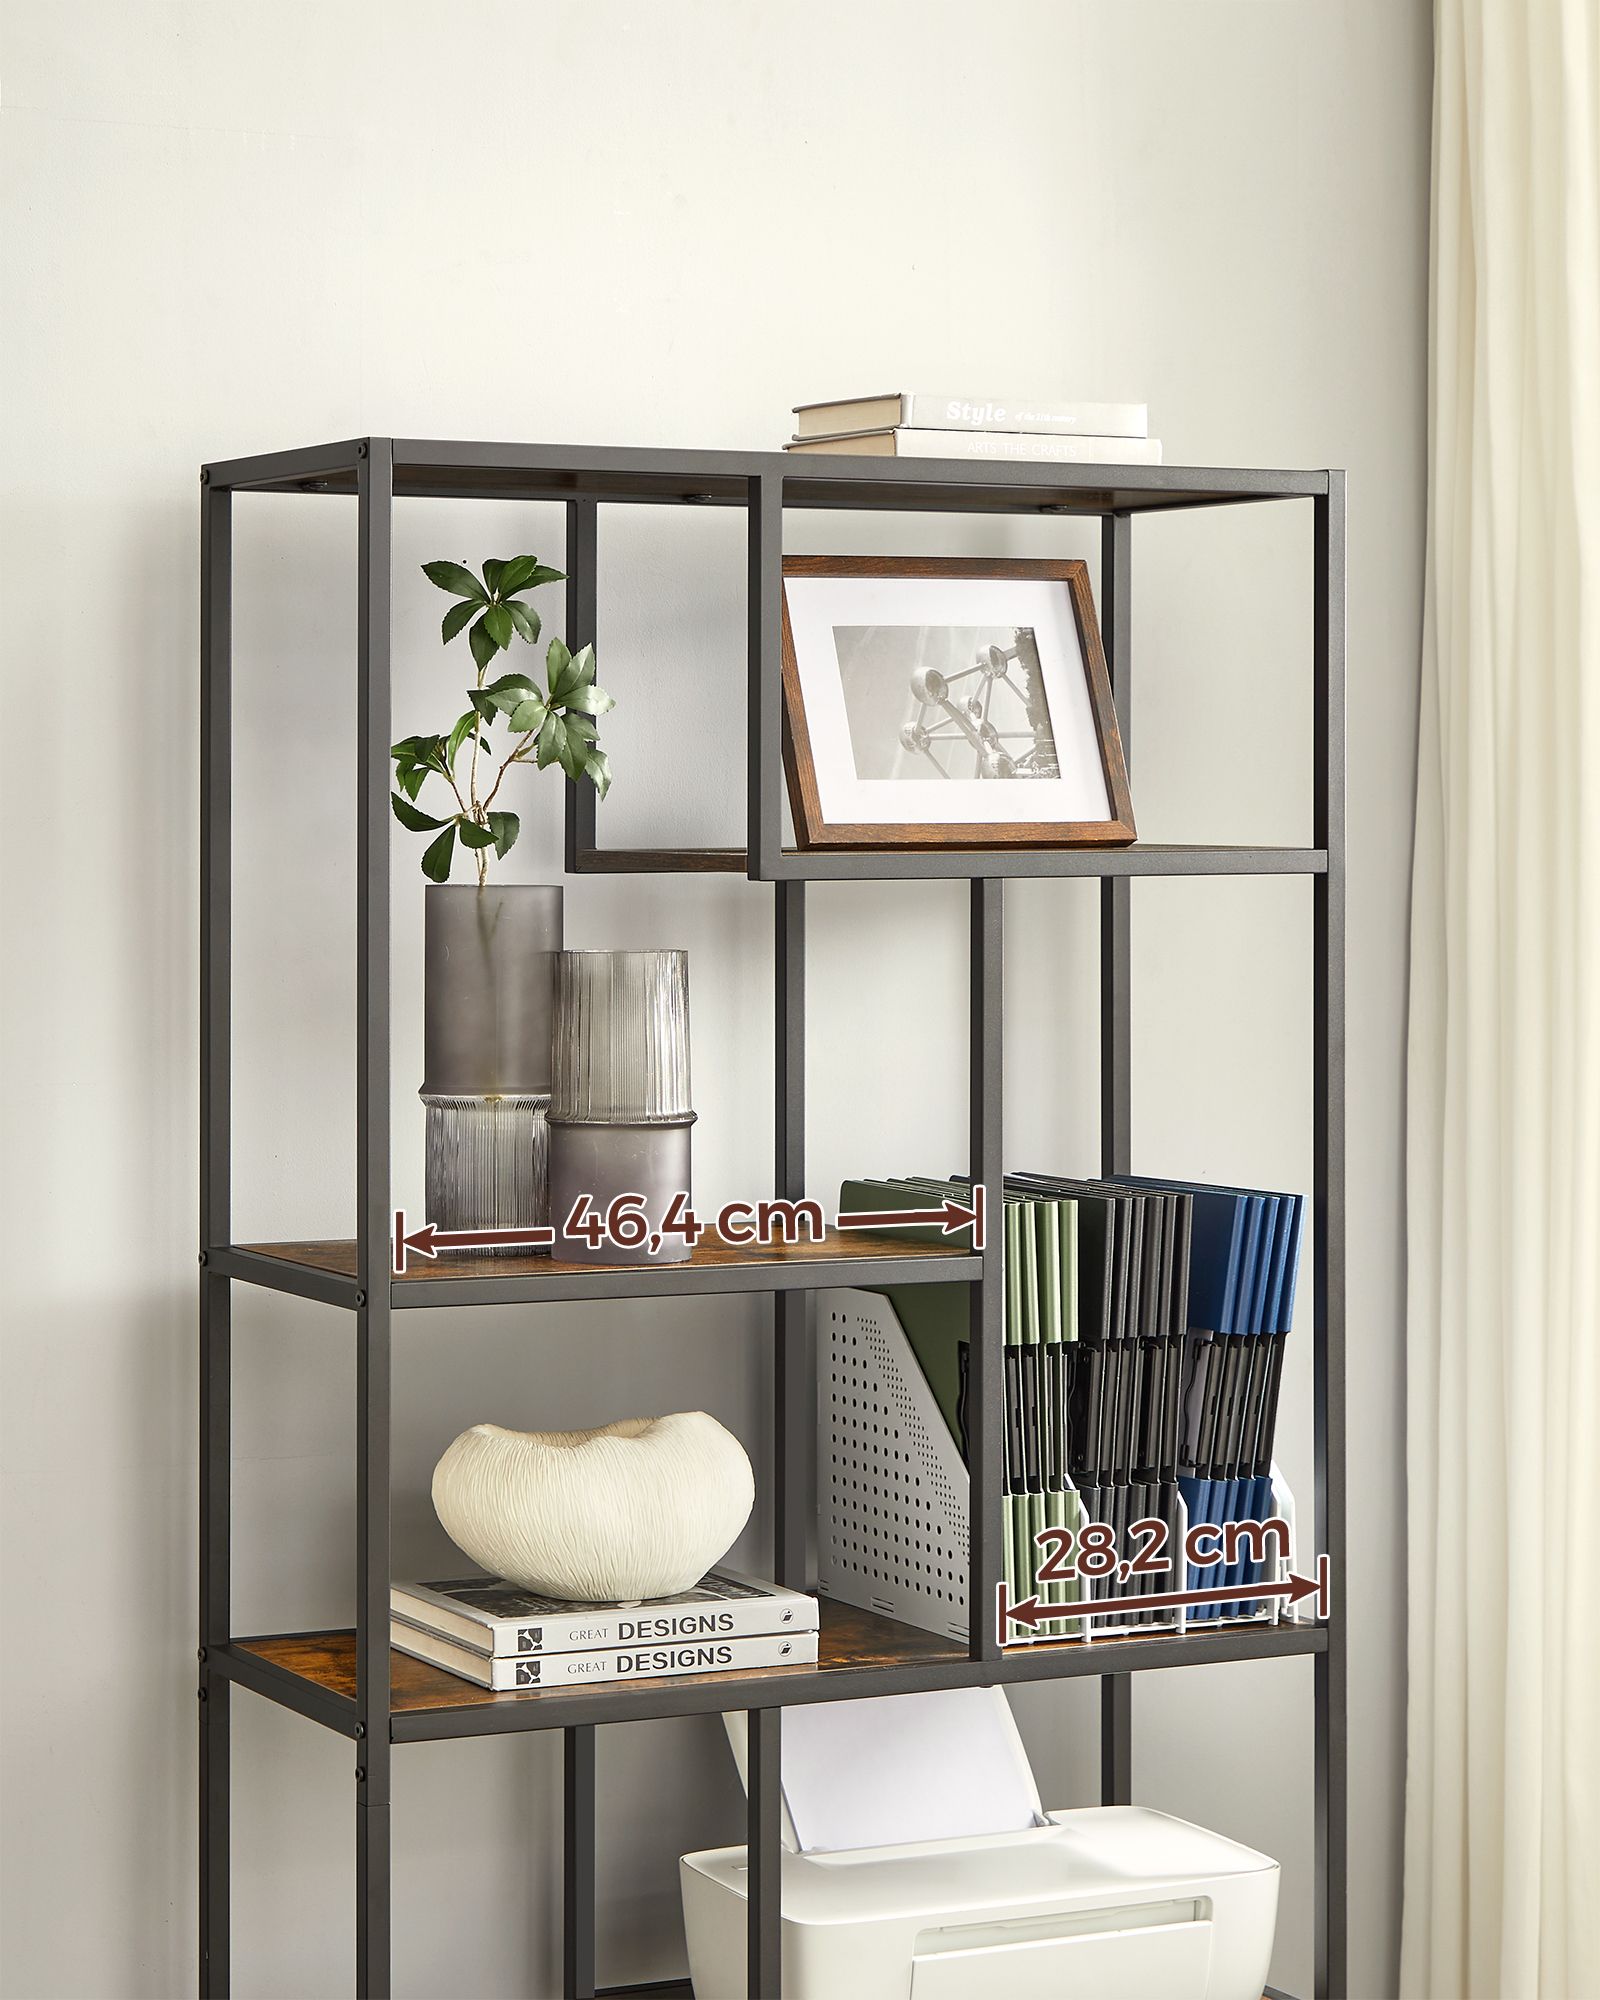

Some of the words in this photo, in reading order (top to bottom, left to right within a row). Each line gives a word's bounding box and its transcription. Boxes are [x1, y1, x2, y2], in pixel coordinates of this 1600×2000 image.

[947, 402, 1006, 426] Style
[967, 441, 997, 456] ARTS
[1004, 443, 1027, 457] THE
[1031, 445, 1077, 459] CRAFTS
[569, 1628, 608, 1641] GREAT
[618, 1613, 734, 1641] DESIGNS
[567, 1661, 607, 1674] GREAT
[617, 1646, 733, 1674] DESIGNS
